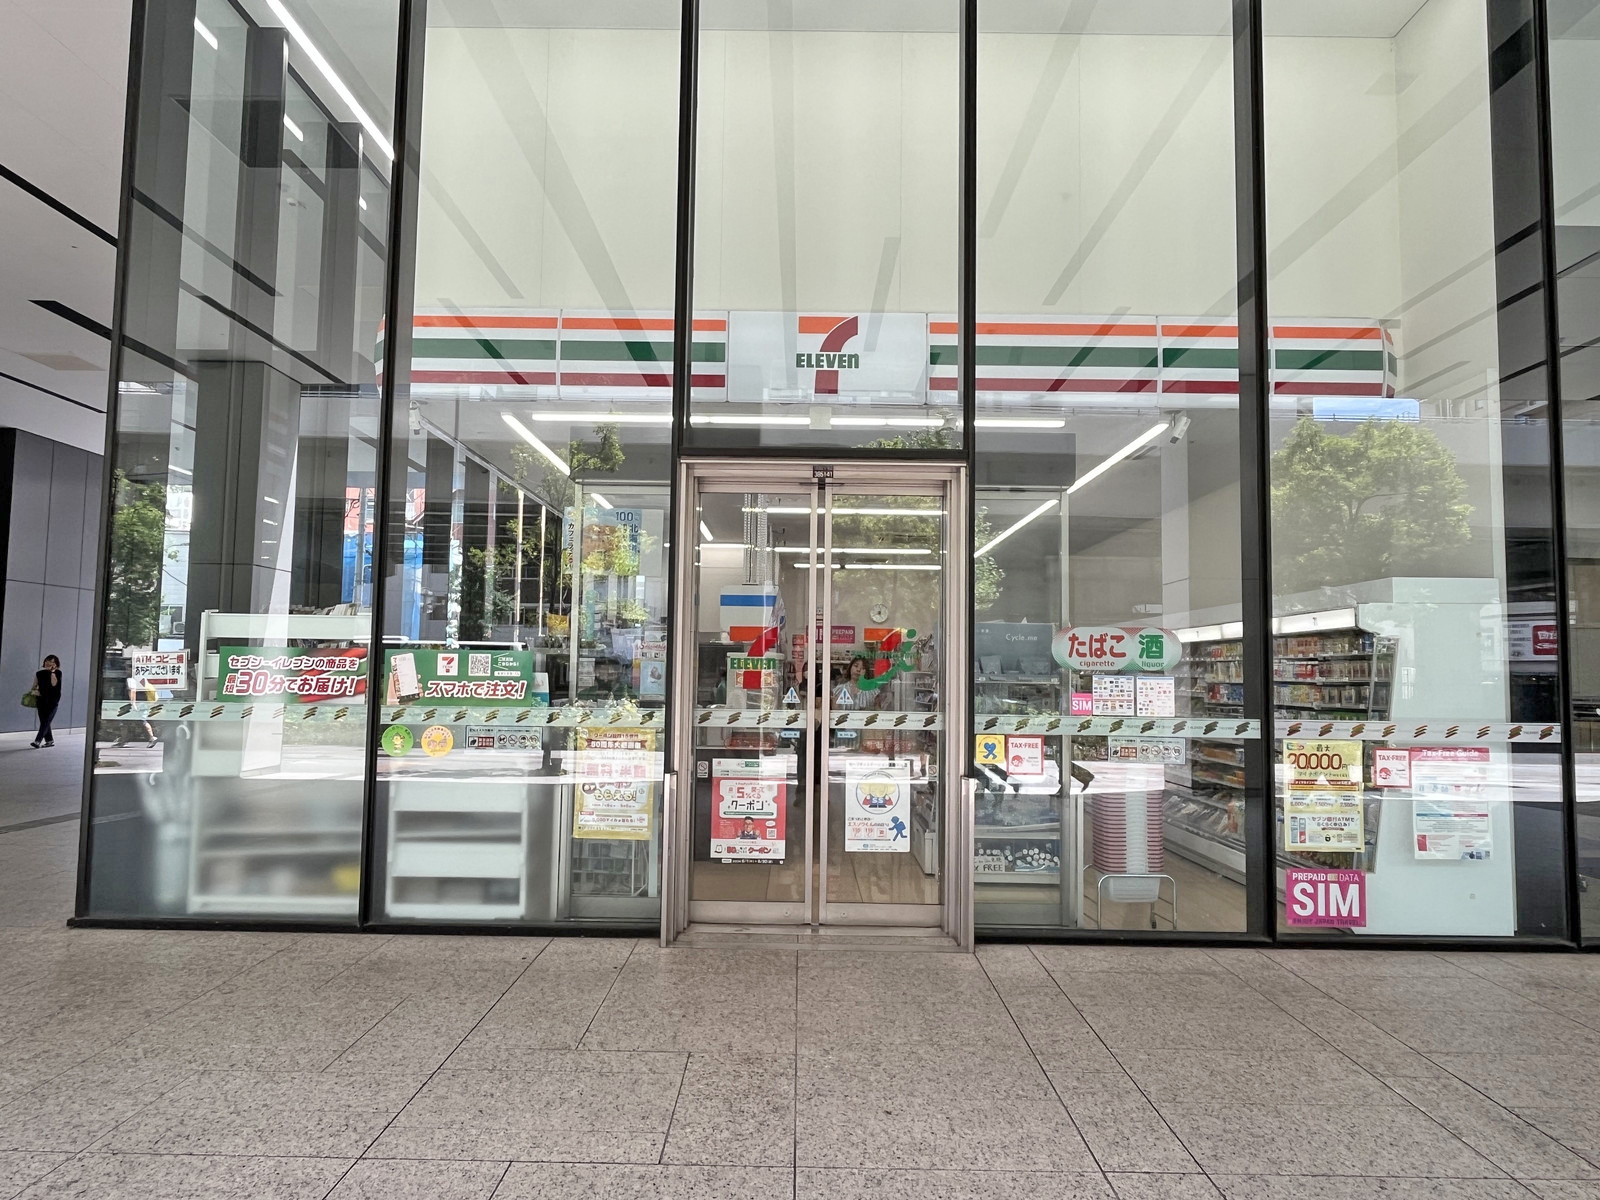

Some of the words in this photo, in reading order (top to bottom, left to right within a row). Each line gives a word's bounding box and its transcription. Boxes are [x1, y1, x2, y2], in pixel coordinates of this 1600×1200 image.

[1068, 633, 1127, 659] たばこ
[1138, 634, 1164, 660] 酒
[1079, 660, 1116, 668] cigarette
[1141, 660, 1165, 668] liquor
[425, 681, 527, 699] スマホで注文!
[1072, 700, 1092, 711] SIM
[1316, 744, 1331, 752] 最大
[1422, 749, 1455, 757] Tax-Free
[1456, 749, 1479, 757] Guide
[731, 799, 764, 811] クーポン
[983, 864, 1003, 872] FREE
[1292, 872, 1326, 881] PREPAID
[1339, 873, 1360, 882] DATA
[1292, 882, 1360, 917] SIM
